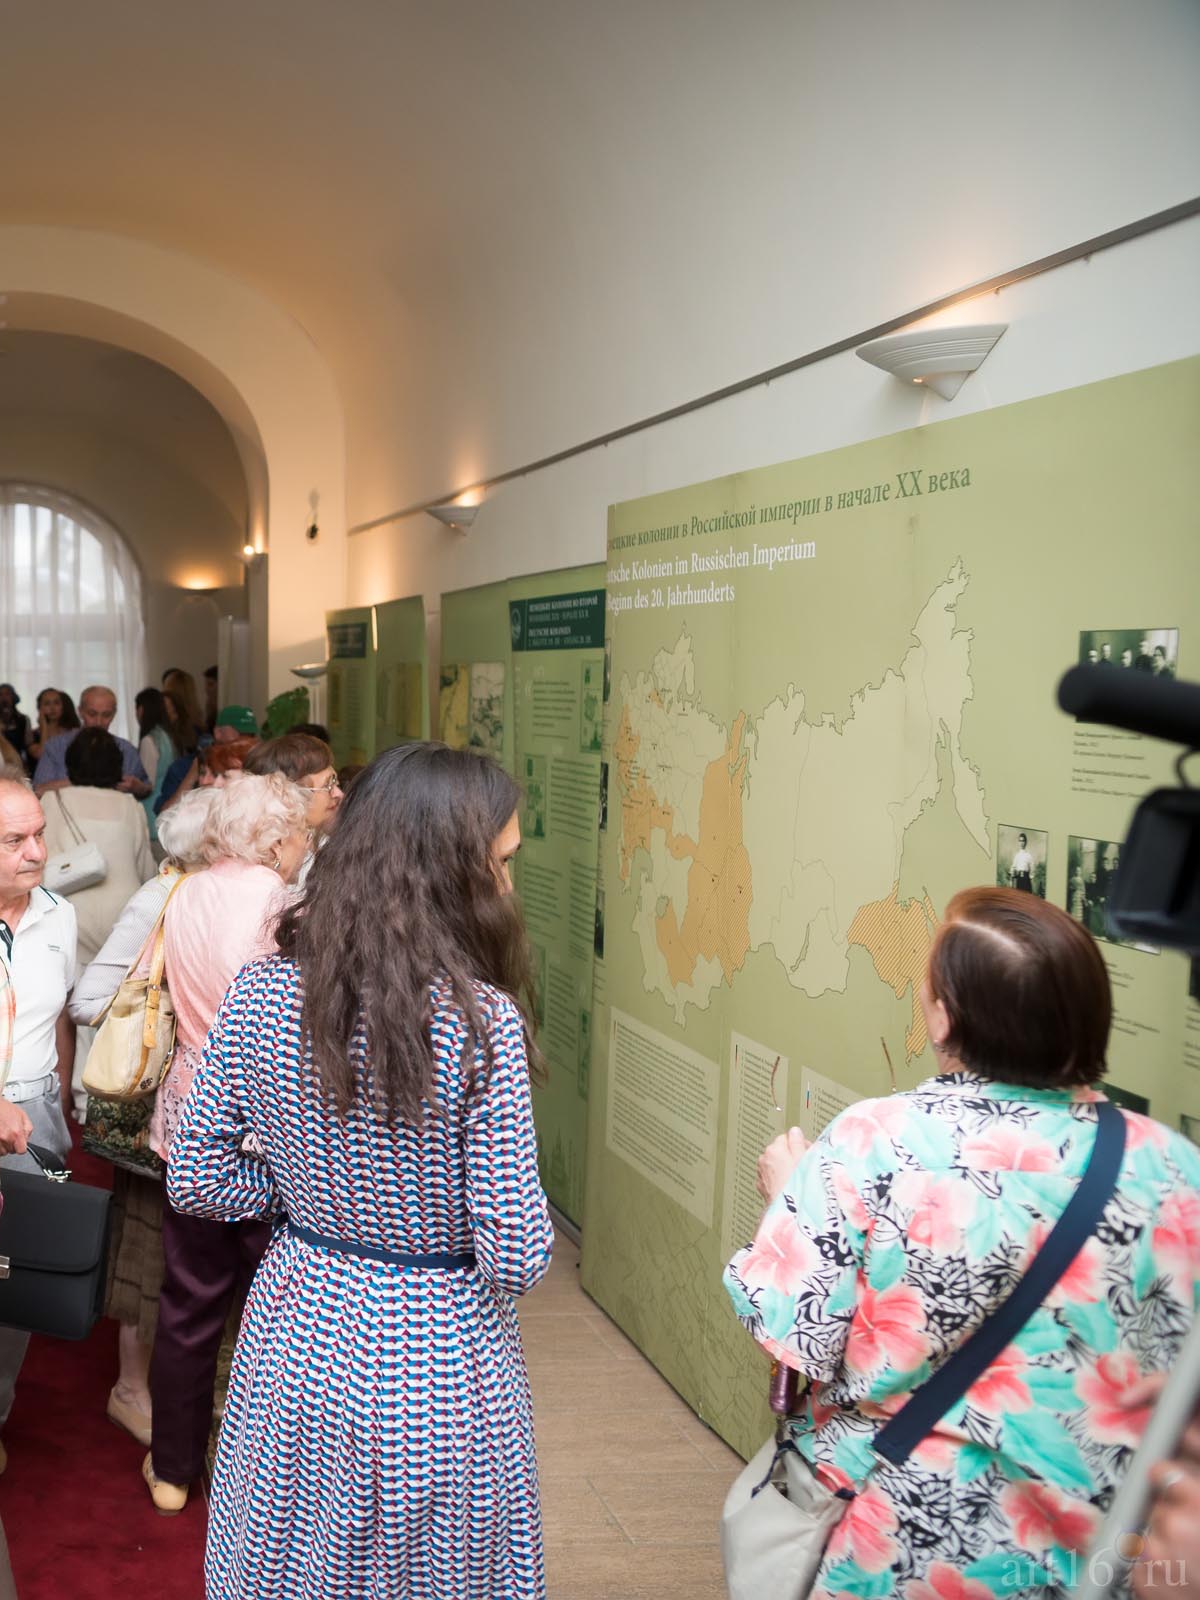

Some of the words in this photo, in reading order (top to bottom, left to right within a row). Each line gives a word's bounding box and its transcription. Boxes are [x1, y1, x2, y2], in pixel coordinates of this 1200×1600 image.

[638, 525, 680, 547] колонии
[682, 523, 689, 538] в
[691, 506, 757, 537] Российской
[760, 496, 821, 526] империи
[824, 494, 833, 513] в
[837, 482, 891, 511] начале
[928, 466, 971, 495] века
[632, 558, 673, 581] Kolonien
[675, 555, 688, 575] im
[691, 545, 749, 574] Russischen
[752, 538, 817, 571] Imperium
[634, 588, 649, 609] des
[651, 587, 665, 608] 20.
[666, 581, 736, 610] Jahrhunderts
